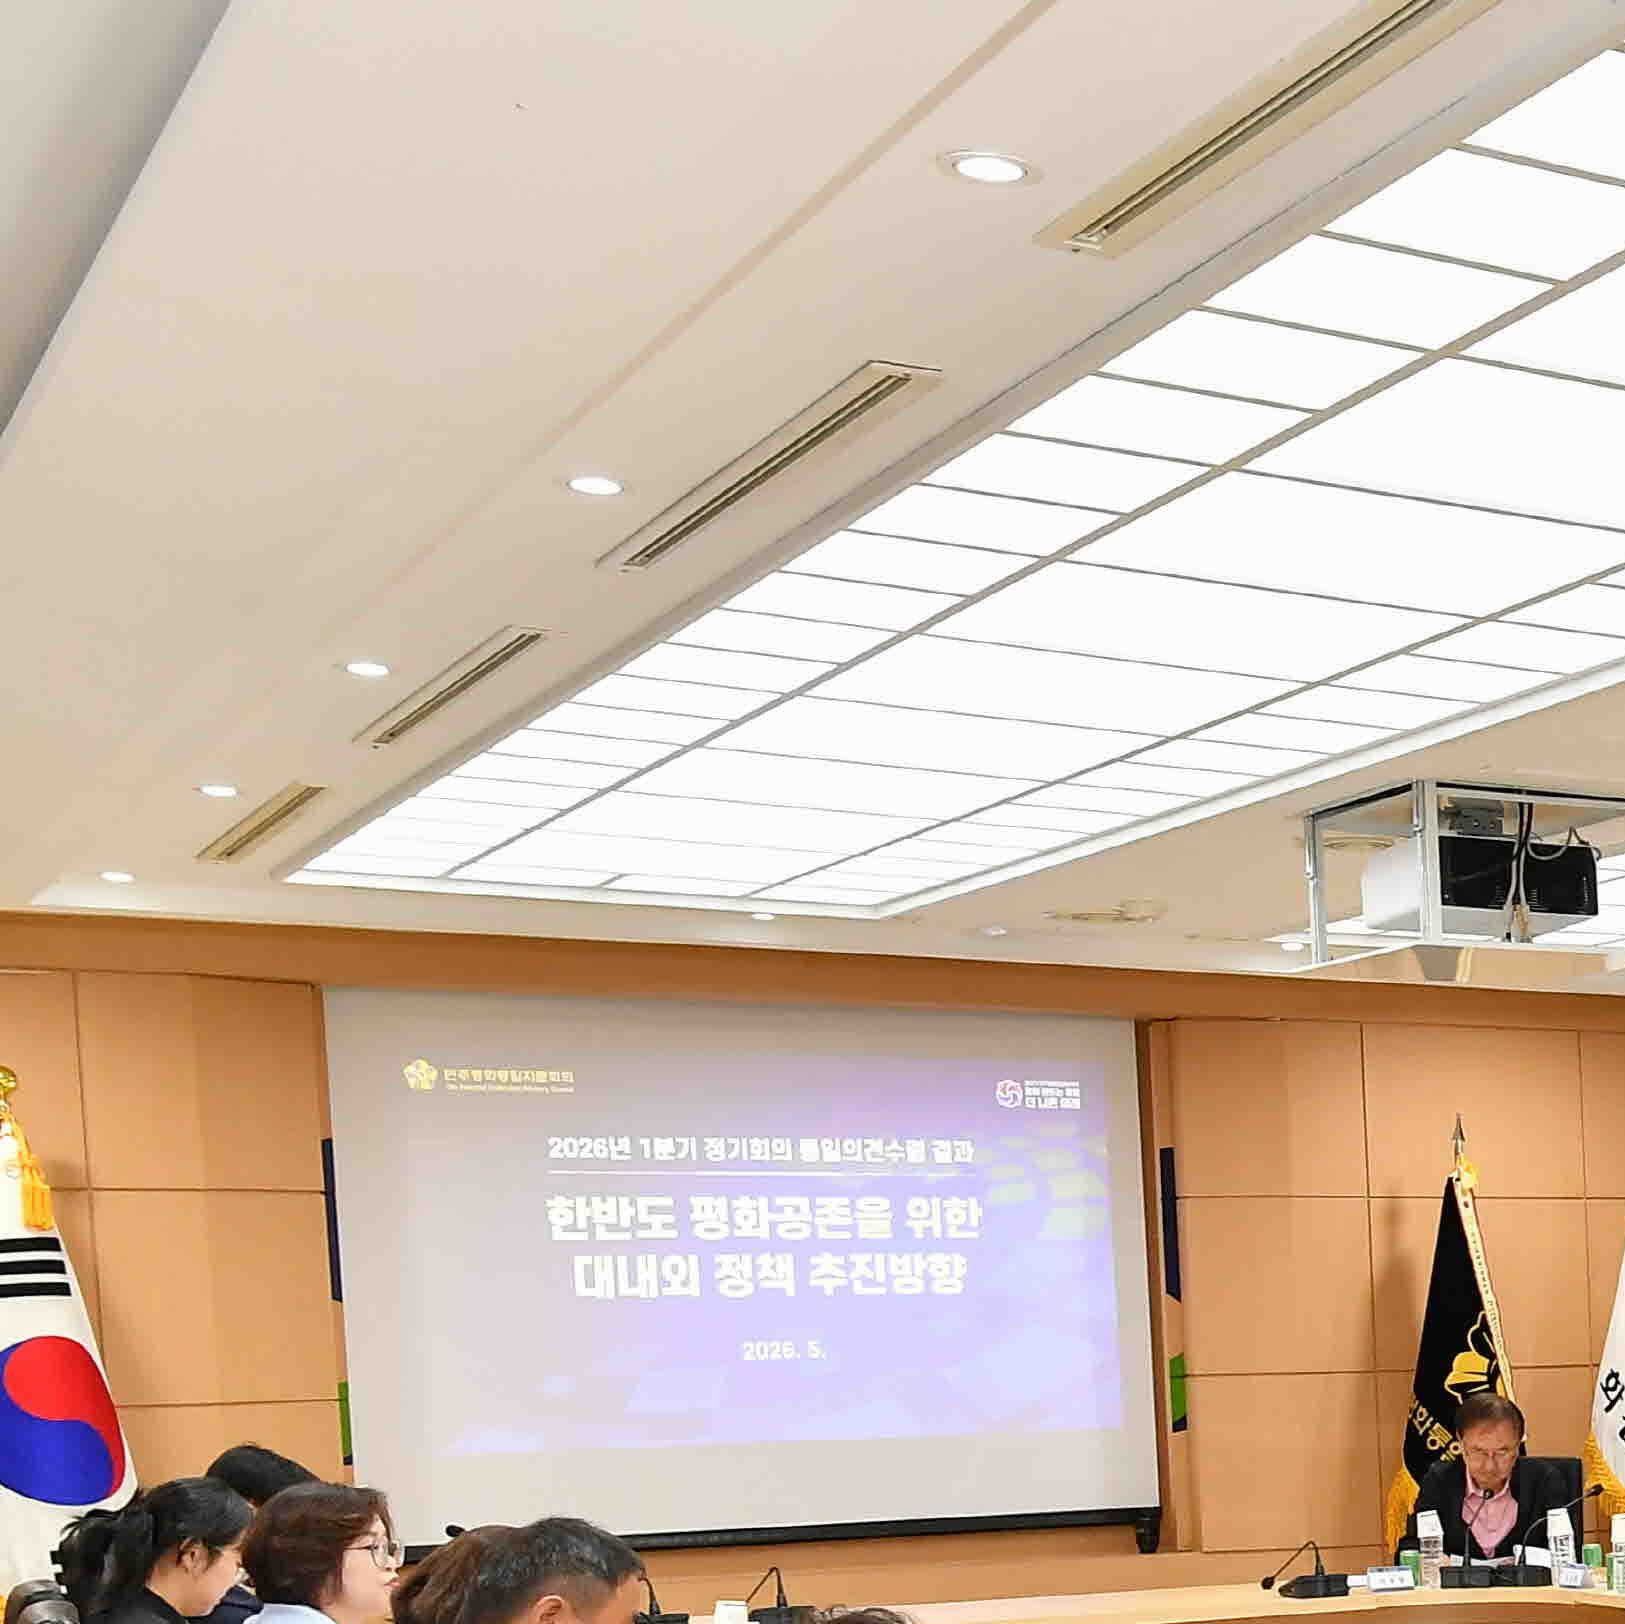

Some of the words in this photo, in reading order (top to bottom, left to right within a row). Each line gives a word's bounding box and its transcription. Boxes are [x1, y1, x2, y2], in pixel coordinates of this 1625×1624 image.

[547, 1136, 631, 1160] 2026년
[639, 1137, 697, 1161] 1분기
[703, 1137, 793, 1162] 정기회의
[545, 1195, 679, 1240] 한반도
[688, 1195, 893, 1240] 평화공존을
[905, 1196, 984, 1240] 위한
[573, 1253, 701, 1298] 대내외
[715, 1252, 796, 1297] 정책
[809, 1252, 968, 1296] 추진방향
